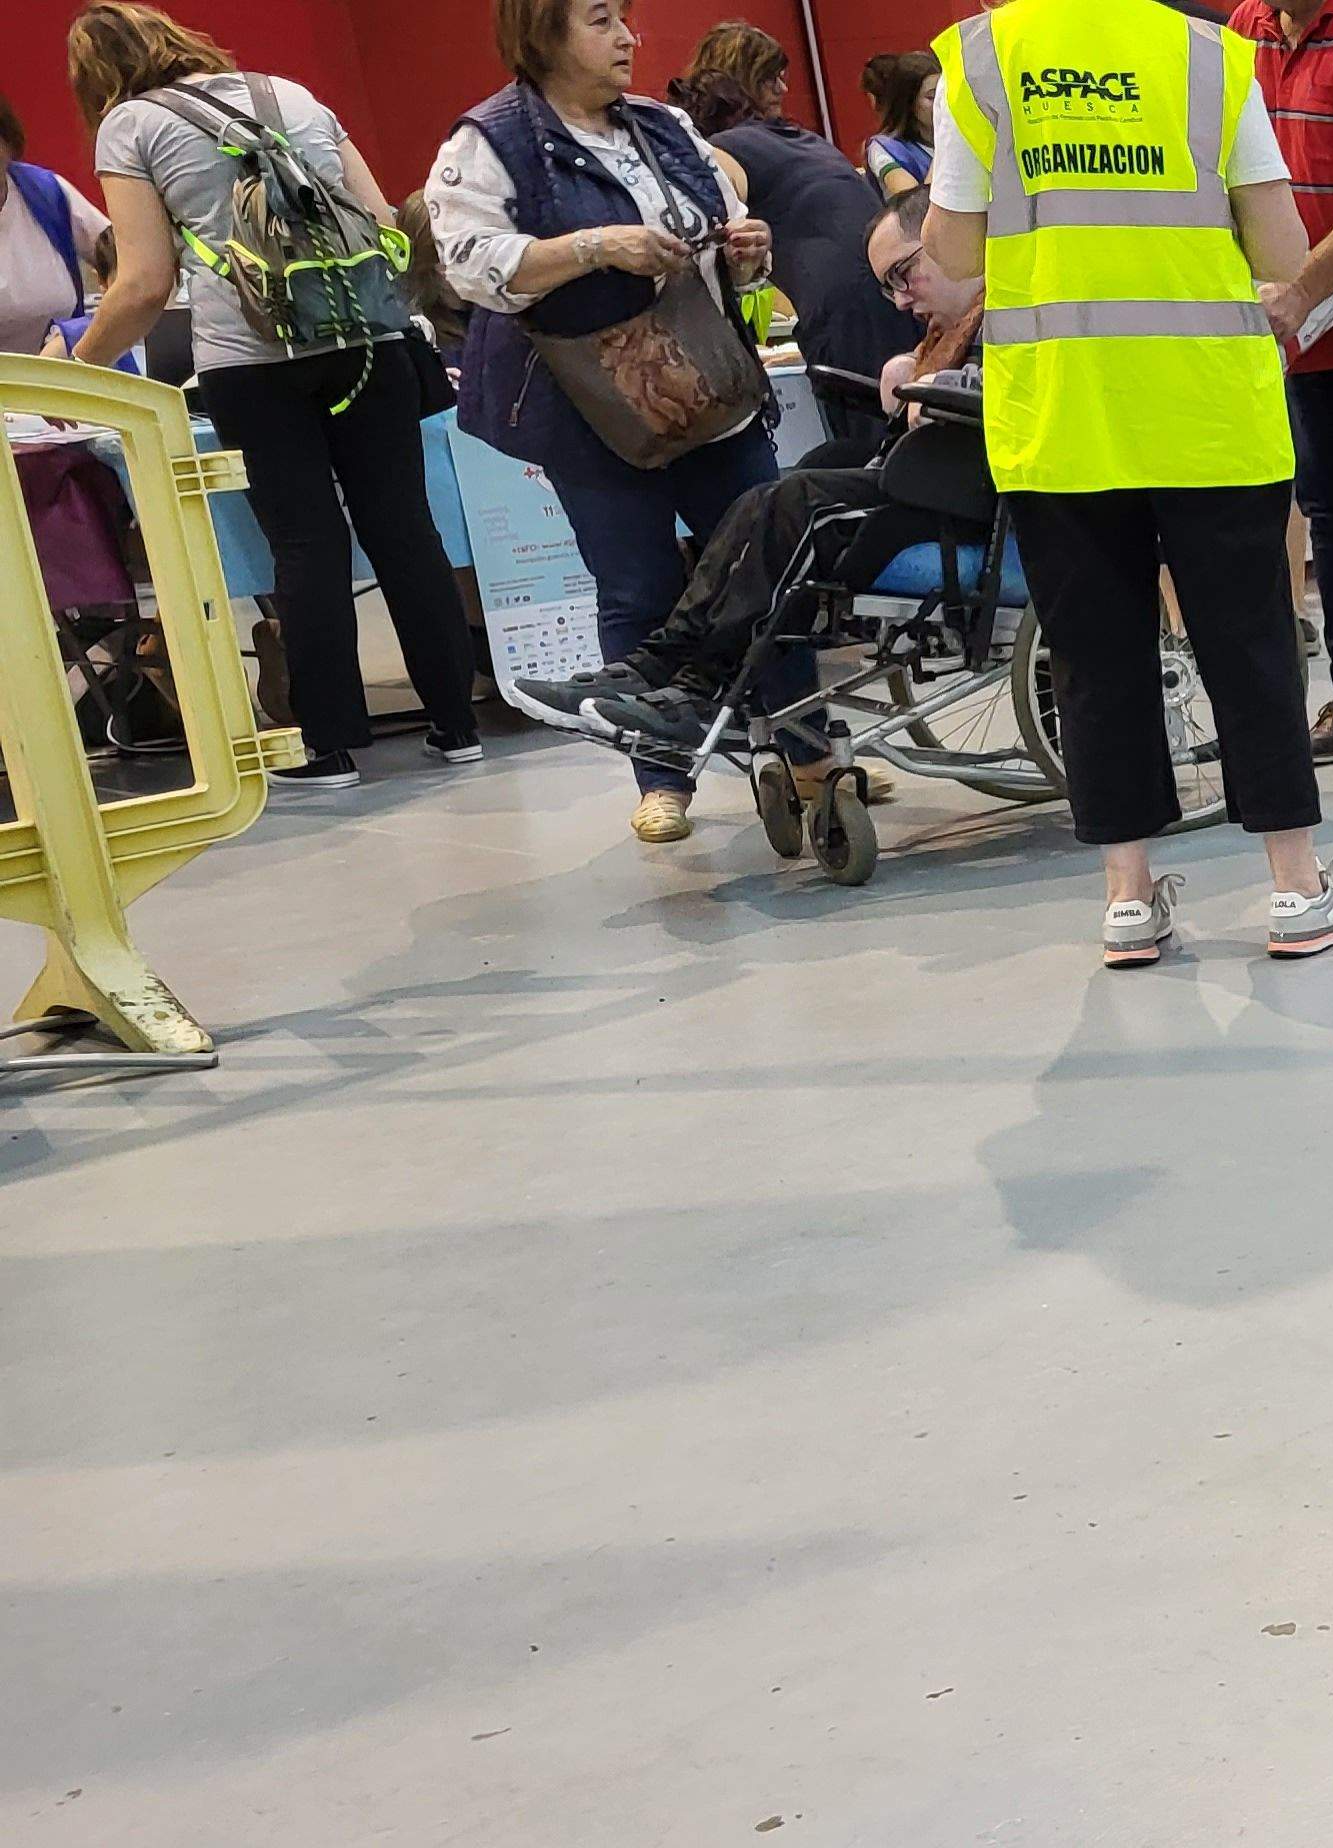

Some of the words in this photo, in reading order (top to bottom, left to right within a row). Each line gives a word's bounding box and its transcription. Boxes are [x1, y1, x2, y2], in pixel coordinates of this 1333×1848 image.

[1021, 68, 1140, 102] ASPACE
[1023, 101, 1139, 114] HUESCA
[1022, 143, 1165, 179] ORGANIZACION
[1275, 900, 1296, 908] LOLA
[1113, 909, 1141, 918] BIMBA
